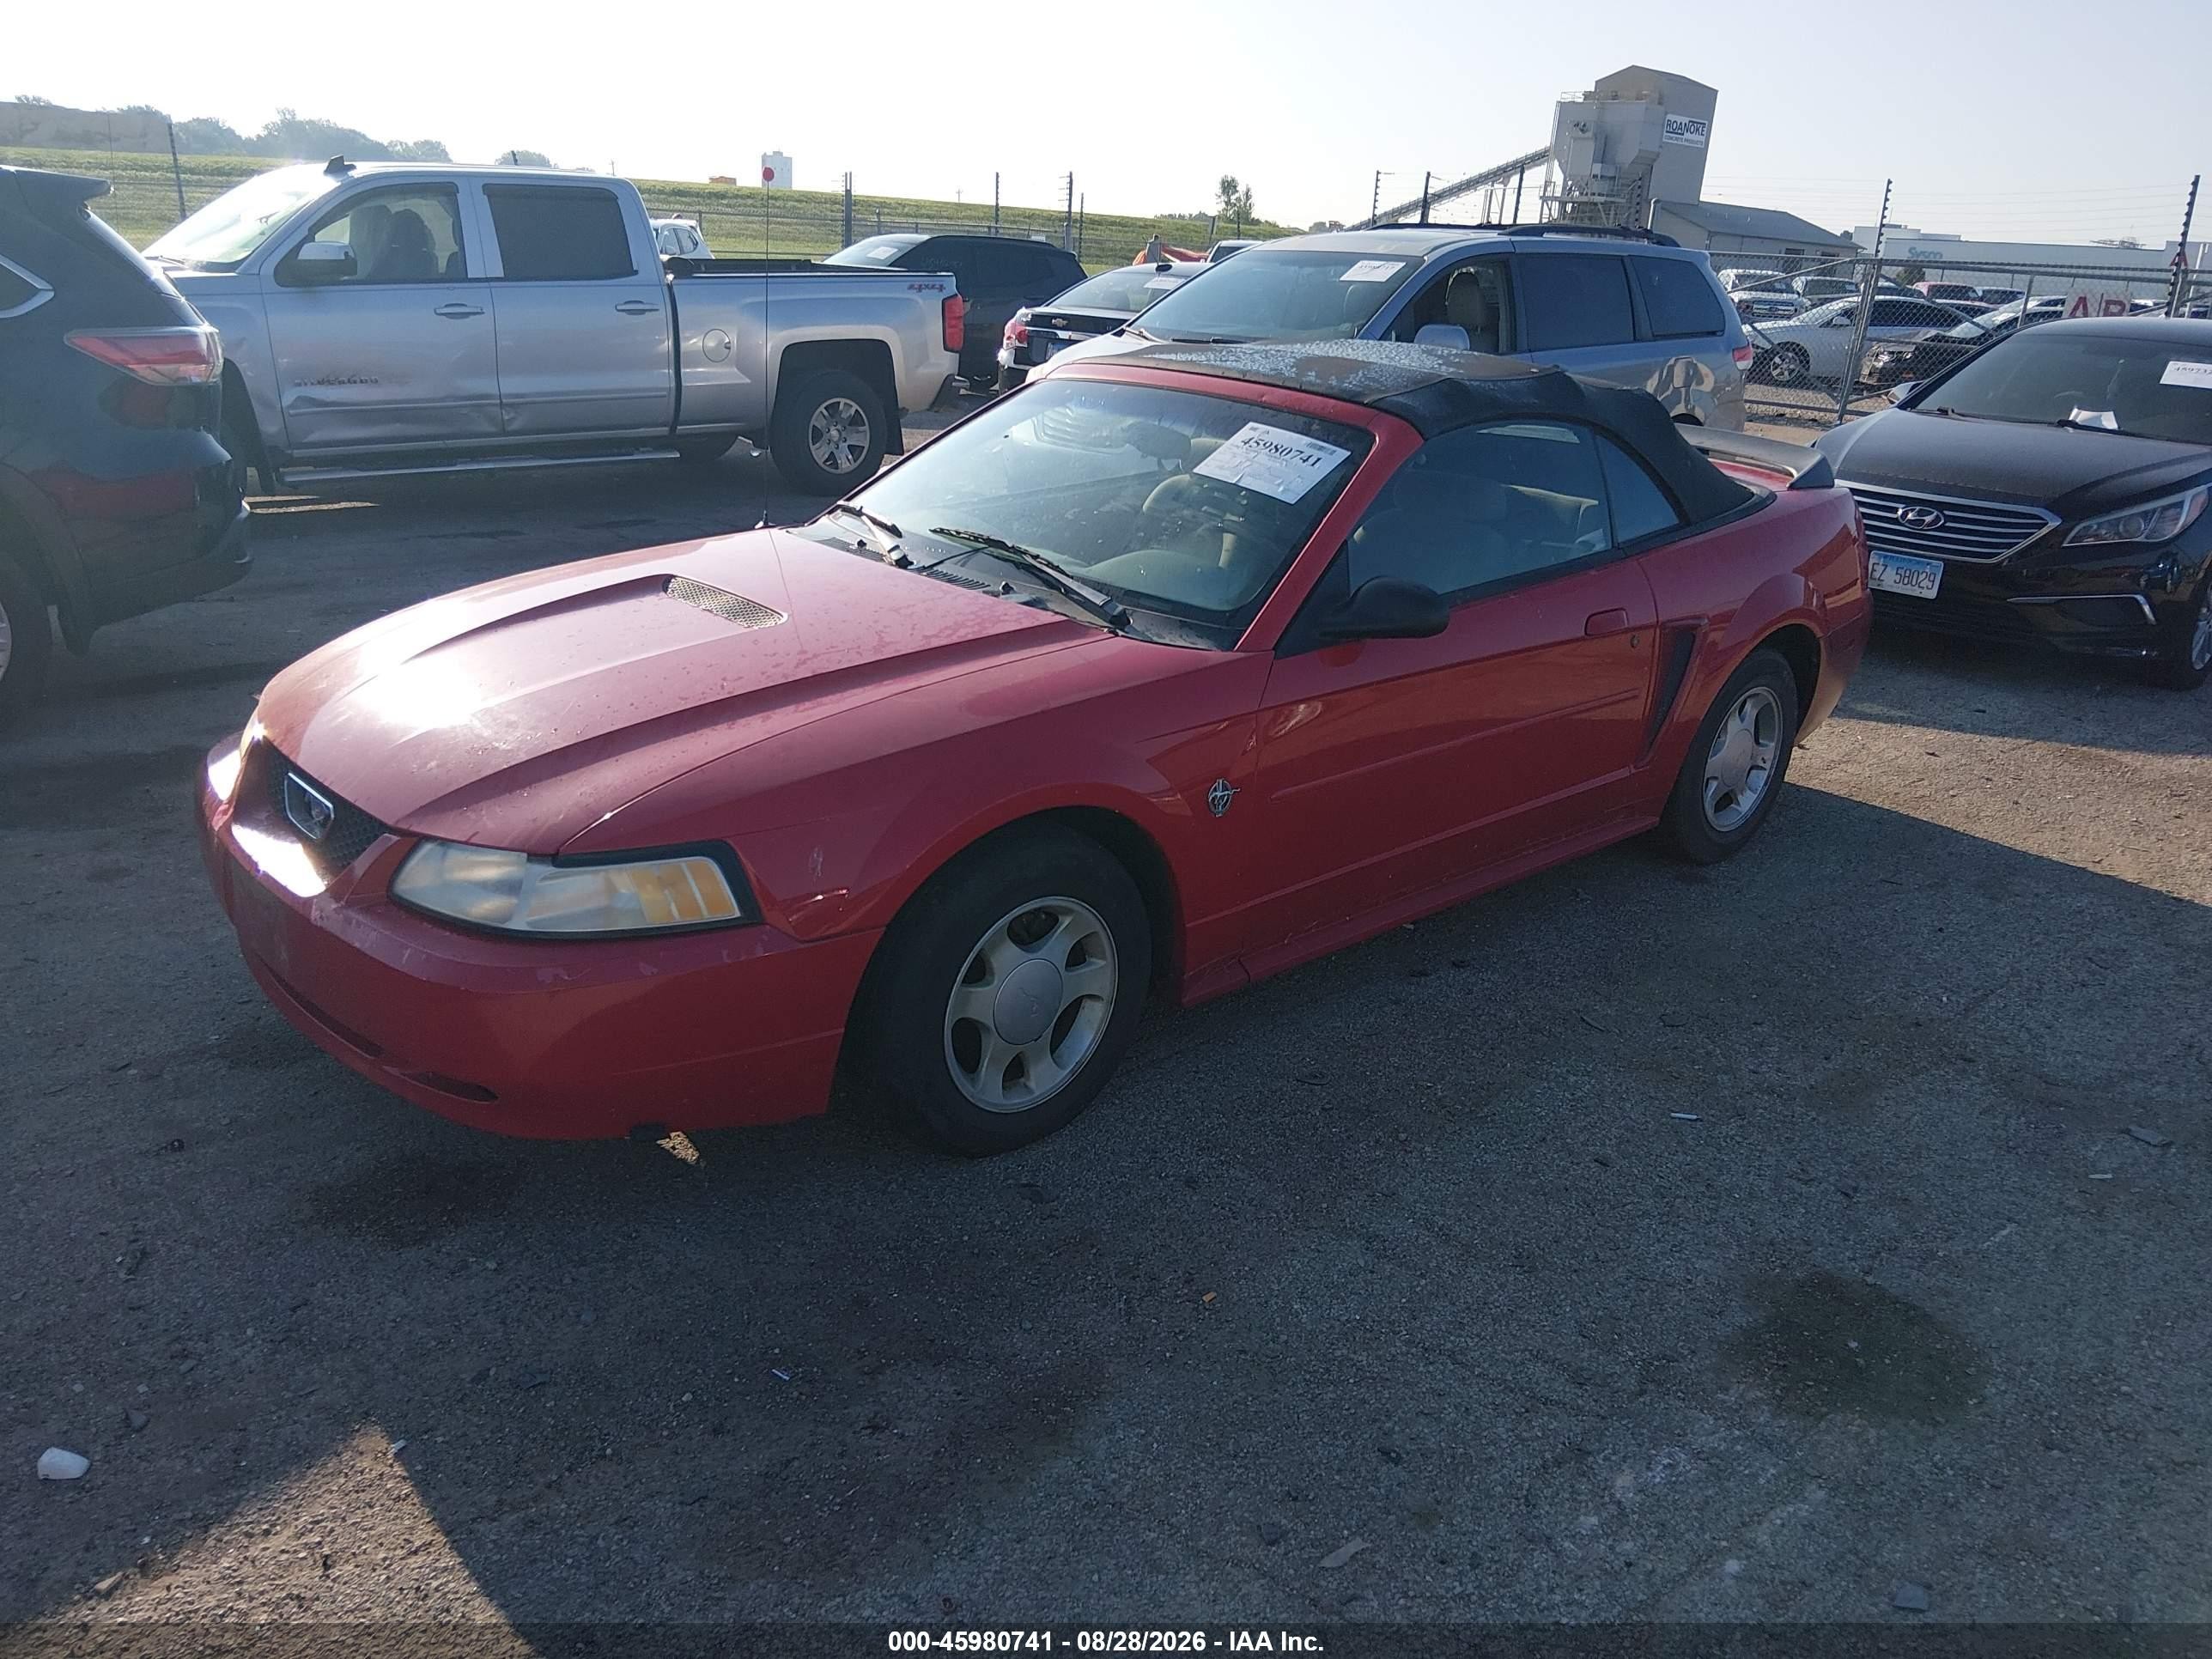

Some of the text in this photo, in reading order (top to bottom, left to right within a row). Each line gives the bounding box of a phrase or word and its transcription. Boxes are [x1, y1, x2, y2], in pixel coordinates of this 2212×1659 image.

[1666, 118, 1706, 137] ROANOKE
[1241, 436, 1323, 467] 45980741
[1869, 562, 1937, 591] EZ 58029
